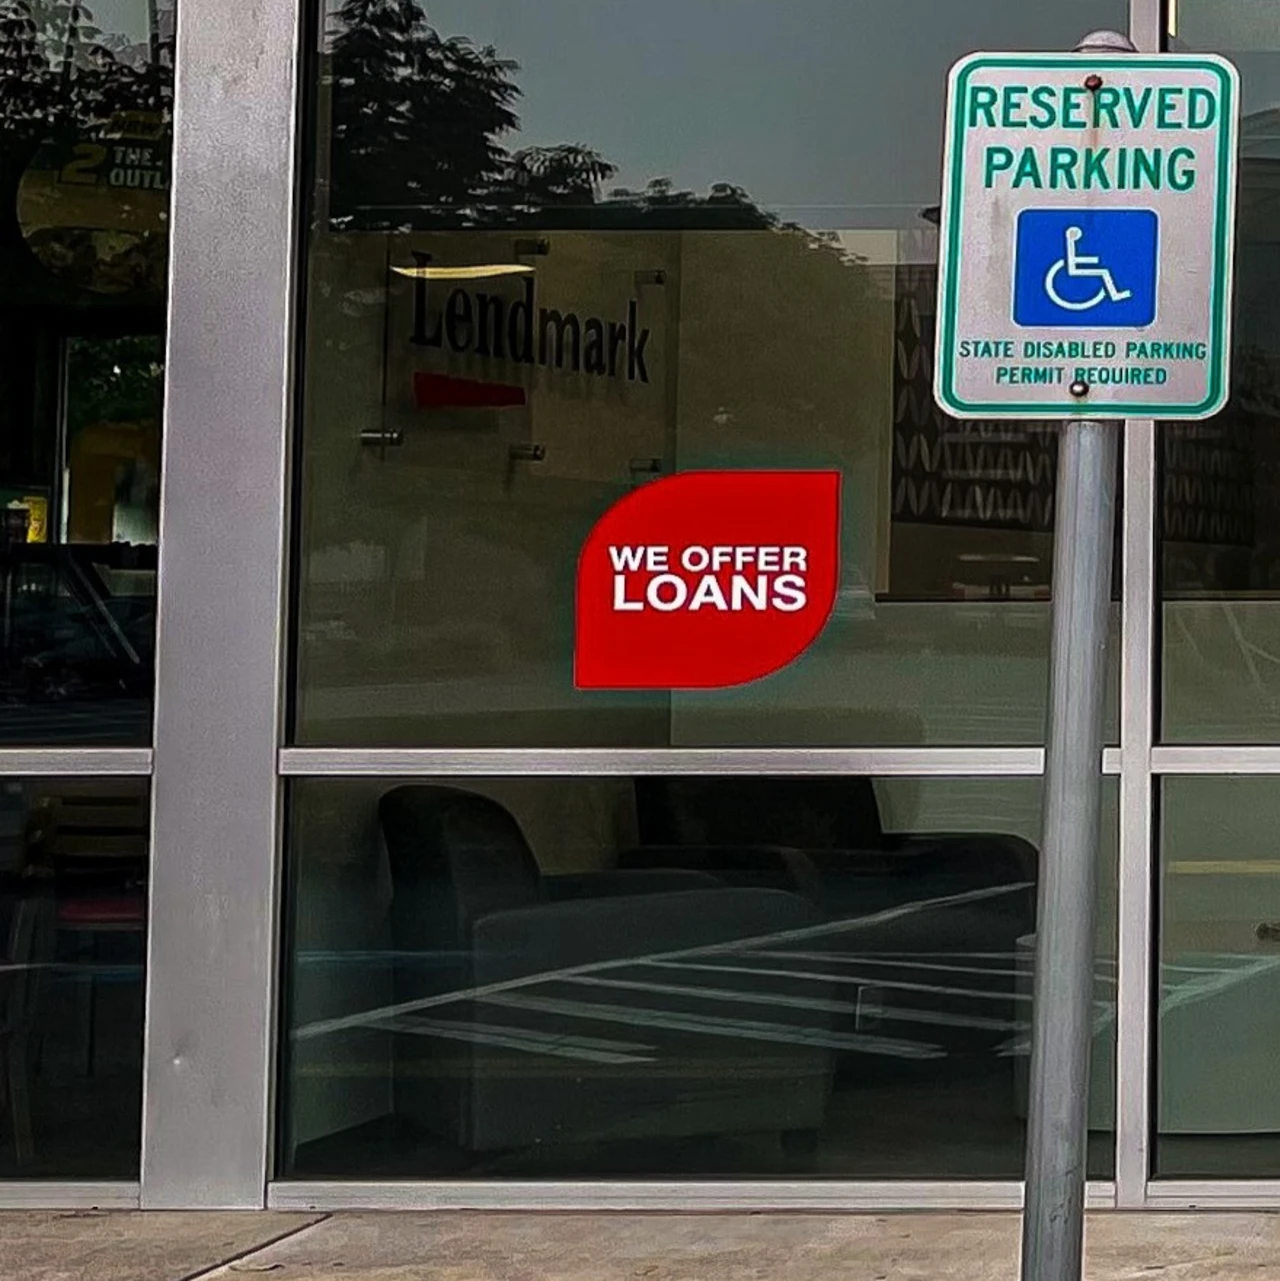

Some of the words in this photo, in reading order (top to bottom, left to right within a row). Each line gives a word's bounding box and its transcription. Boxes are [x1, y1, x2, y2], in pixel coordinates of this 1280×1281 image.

[968, 86, 1216, 129] RESERVED
[984, 146, 1196, 191] PARKING
[409, 250, 649, 383] Lendmark
[959, 340, 1014, 359] STATE
[1023, 341, 1116, 360] DISABLED
[1125, 342, 1207, 360] PARKING
[996, 366, 1063, 385] PERMIT
[1074, 367, 1167, 385] REQUIRED
[608, 545, 669, 571] WE
[681, 545, 807, 572] OFFER
[612, 573, 807, 612] LOANS
